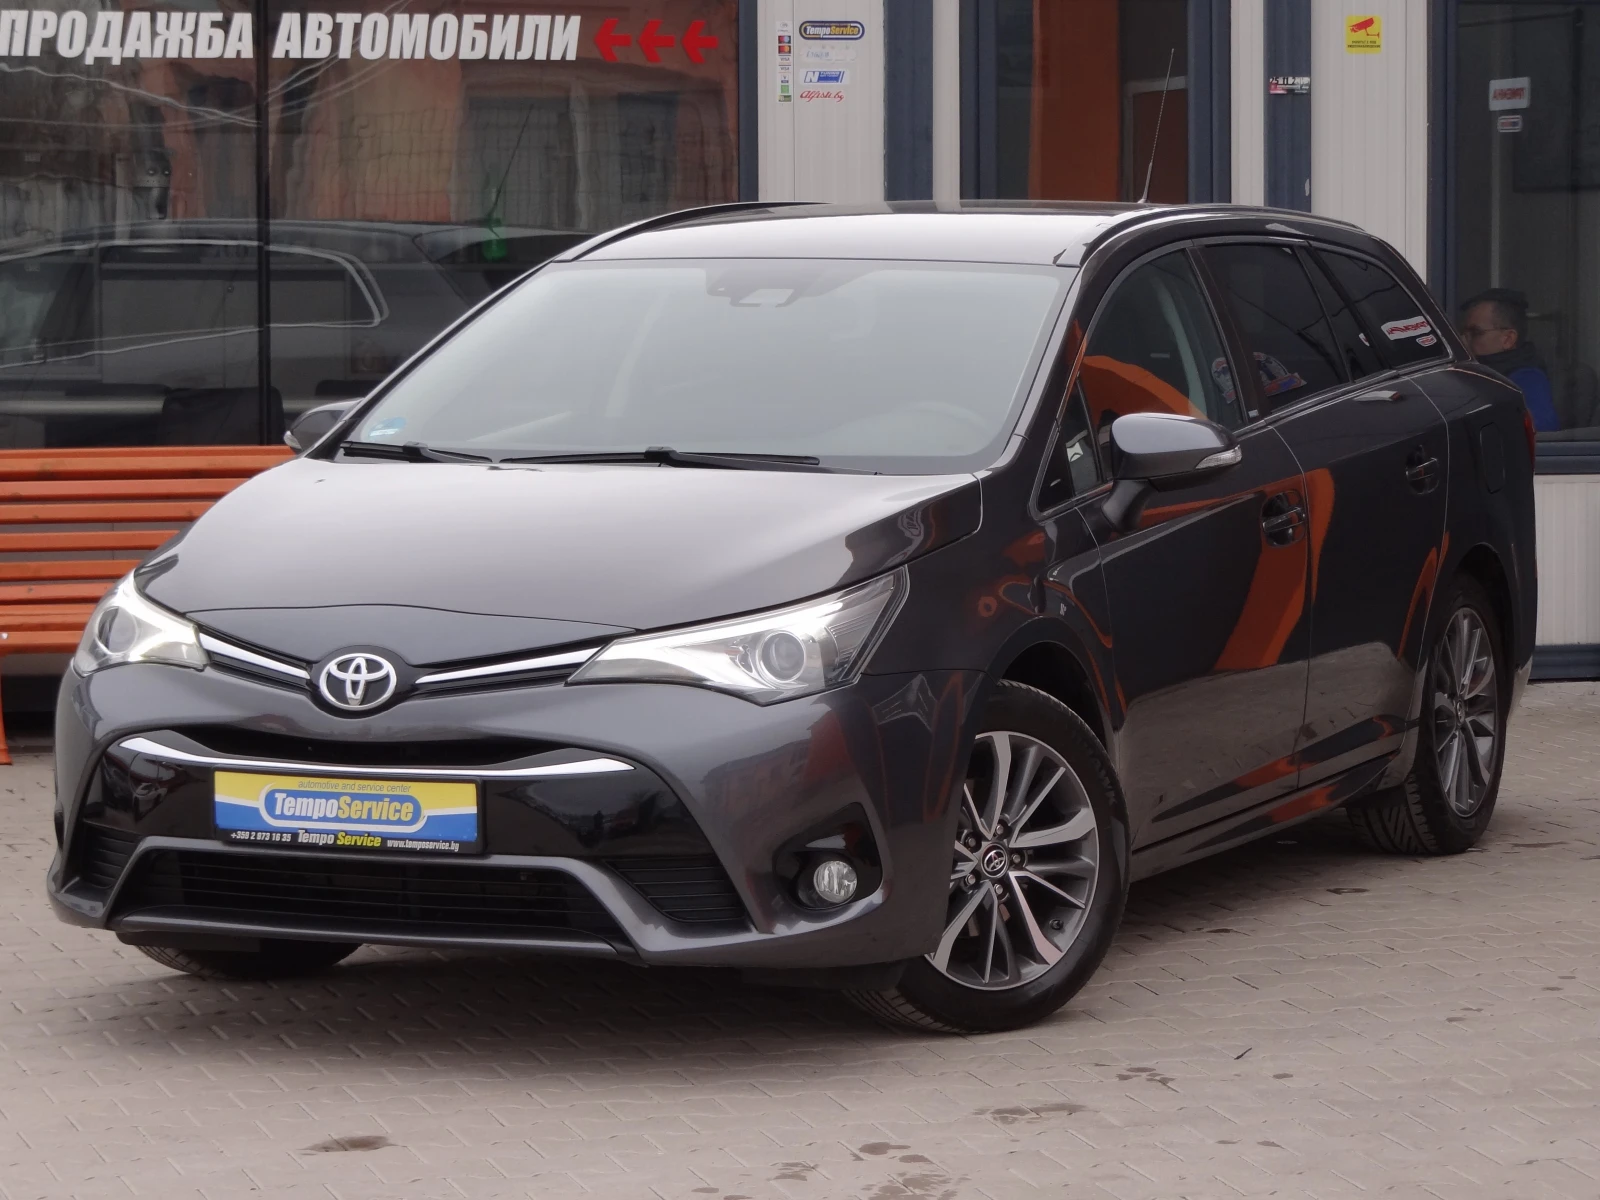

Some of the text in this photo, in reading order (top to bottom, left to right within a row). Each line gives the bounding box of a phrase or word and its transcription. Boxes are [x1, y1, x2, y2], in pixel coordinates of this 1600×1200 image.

[0, 10, 581, 65] ПРОДАЖБА АВТОМОБИЛИ
[298, 780, 412, 793] automotive and service center
[275, 793, 413, 821] TempoService
[231, 831, 250, 840] +359
[250, 831, 256, 840] 2
[281, 833, 292, 842] 35
[297, 829, 335, 846] Tempo
[336, 832, 381, 847] Service
